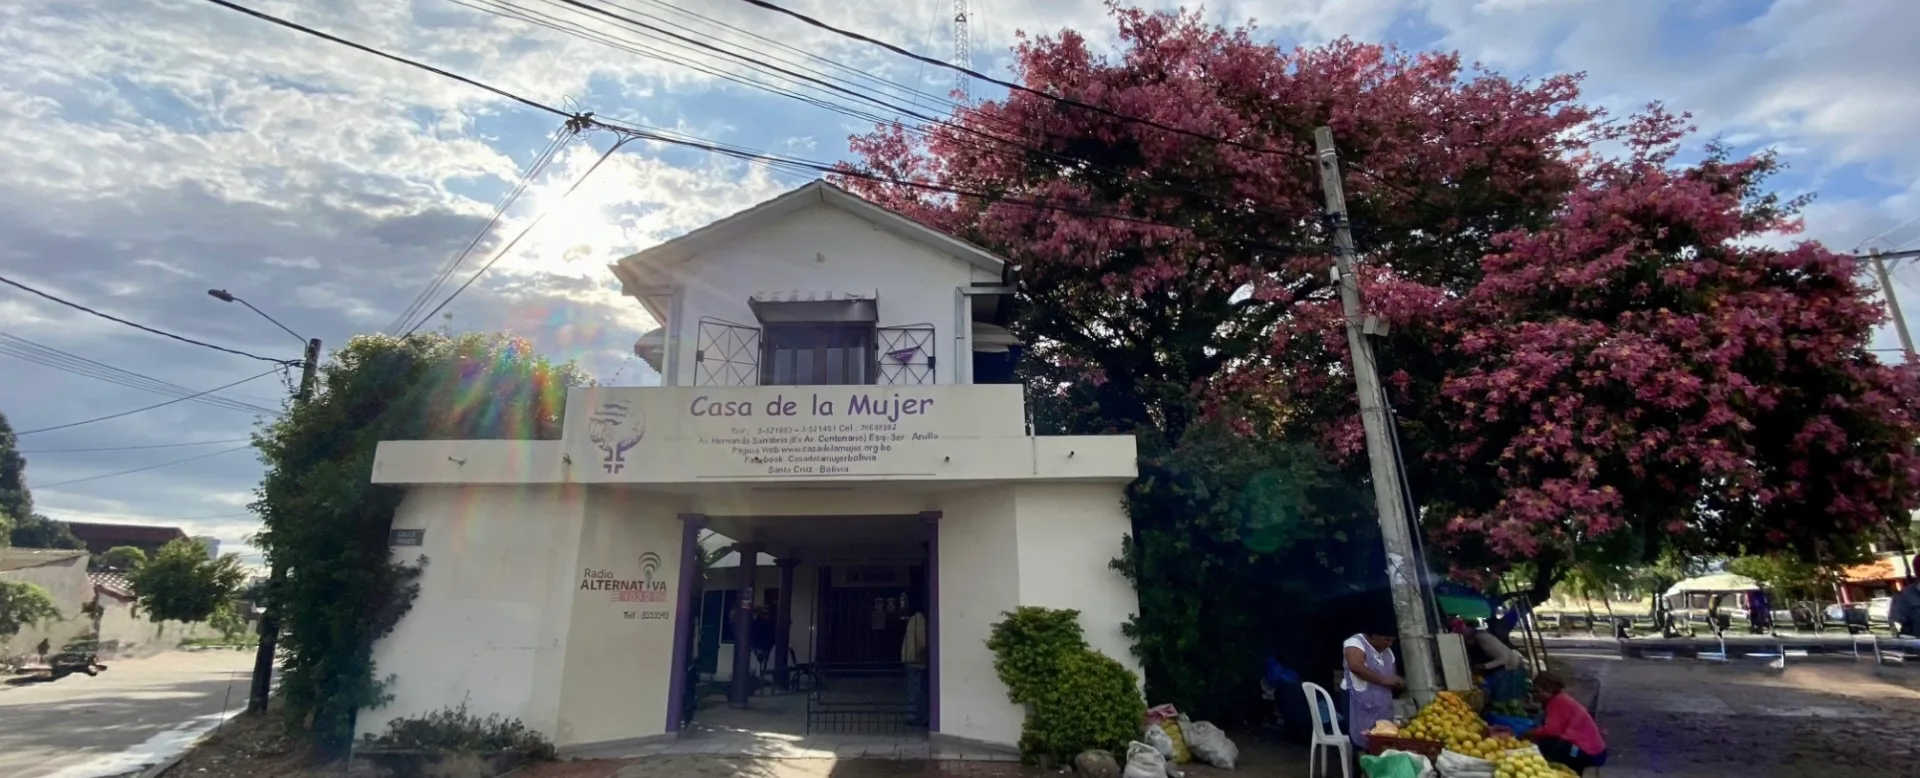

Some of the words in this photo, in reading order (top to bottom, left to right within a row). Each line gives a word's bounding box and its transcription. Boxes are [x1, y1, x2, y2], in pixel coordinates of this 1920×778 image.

[690, 396, 752, 417] Casa
[766, 394, 798, 416] de
[812, 393, 834, 416] la
[847, 393, 934, 423] Mujer
[711, 436, 750, 445] Hernando
[752, 436, 788, 445] Sanabria
[911, 432, 939, 441] Anillo
[768, 466, 791, 474] Santa
[793, 466, 813, 474] Cruz
[819, 465, 849, 473] Bolivia
[584, 568, 614, 579] Radio
